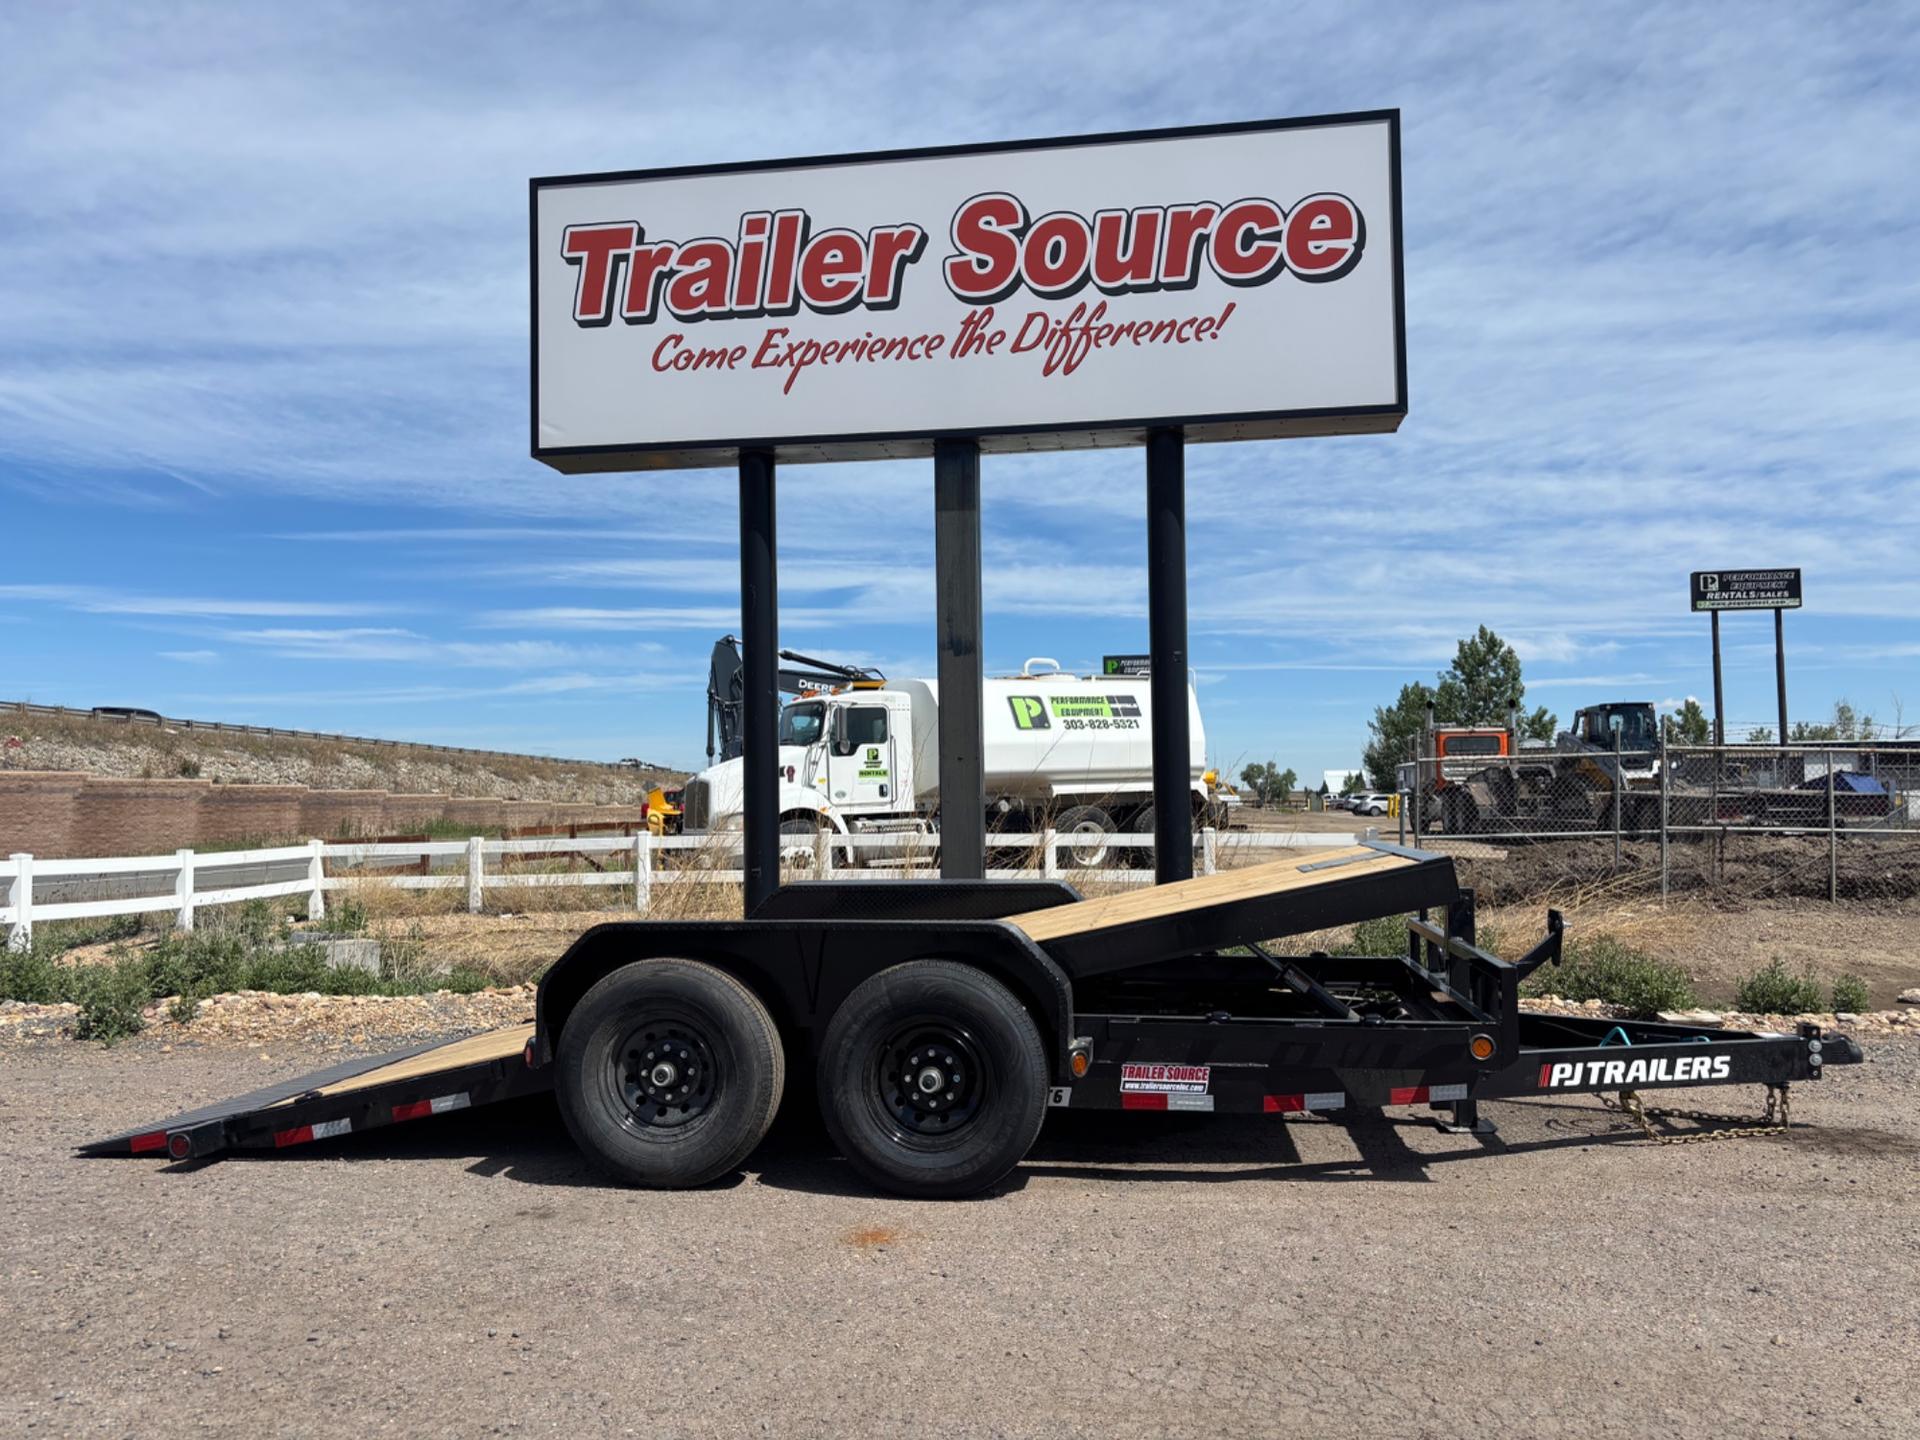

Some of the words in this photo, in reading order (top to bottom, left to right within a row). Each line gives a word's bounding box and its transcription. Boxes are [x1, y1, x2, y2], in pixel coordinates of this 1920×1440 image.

[562, 208, 929, 326] Trailer
[943, 191, 1367, 306] Source
[651, 333, 748, 373] Come
[751, 327, 946, 395] Experience
[950, 306, 1007, 359] the
[1009, 300, 1237, 377] Difference!
[1048, 695, 1107, 705] PERFORMANCE
[1060, 706, 1105, 717] EQUIPMENT
[1062, 718, 1141, 730] 303-828-5321
[1122, 1065, 1166, 1082] TRAILER
[1166, 1067, 1209, 1082] SOURCE
[1586, 1055, 1732, 1085] TRAILERS
